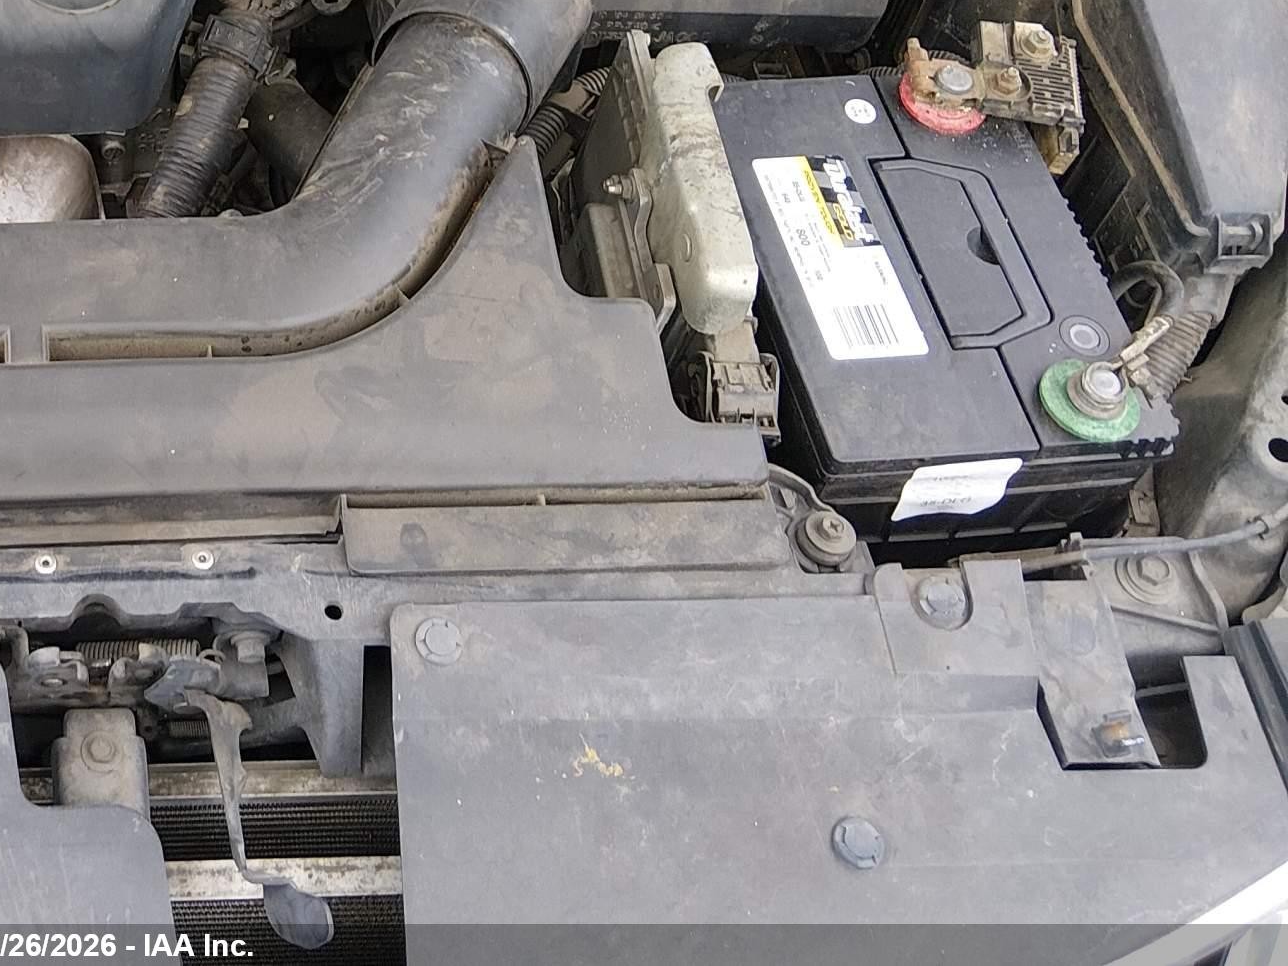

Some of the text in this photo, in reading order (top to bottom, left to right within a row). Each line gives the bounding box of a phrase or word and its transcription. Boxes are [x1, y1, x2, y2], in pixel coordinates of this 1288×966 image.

[821, 159, 875, 243] Duralast
[795, 228, 811, 246] 800
[831, 202, 856, 242] GOLD
